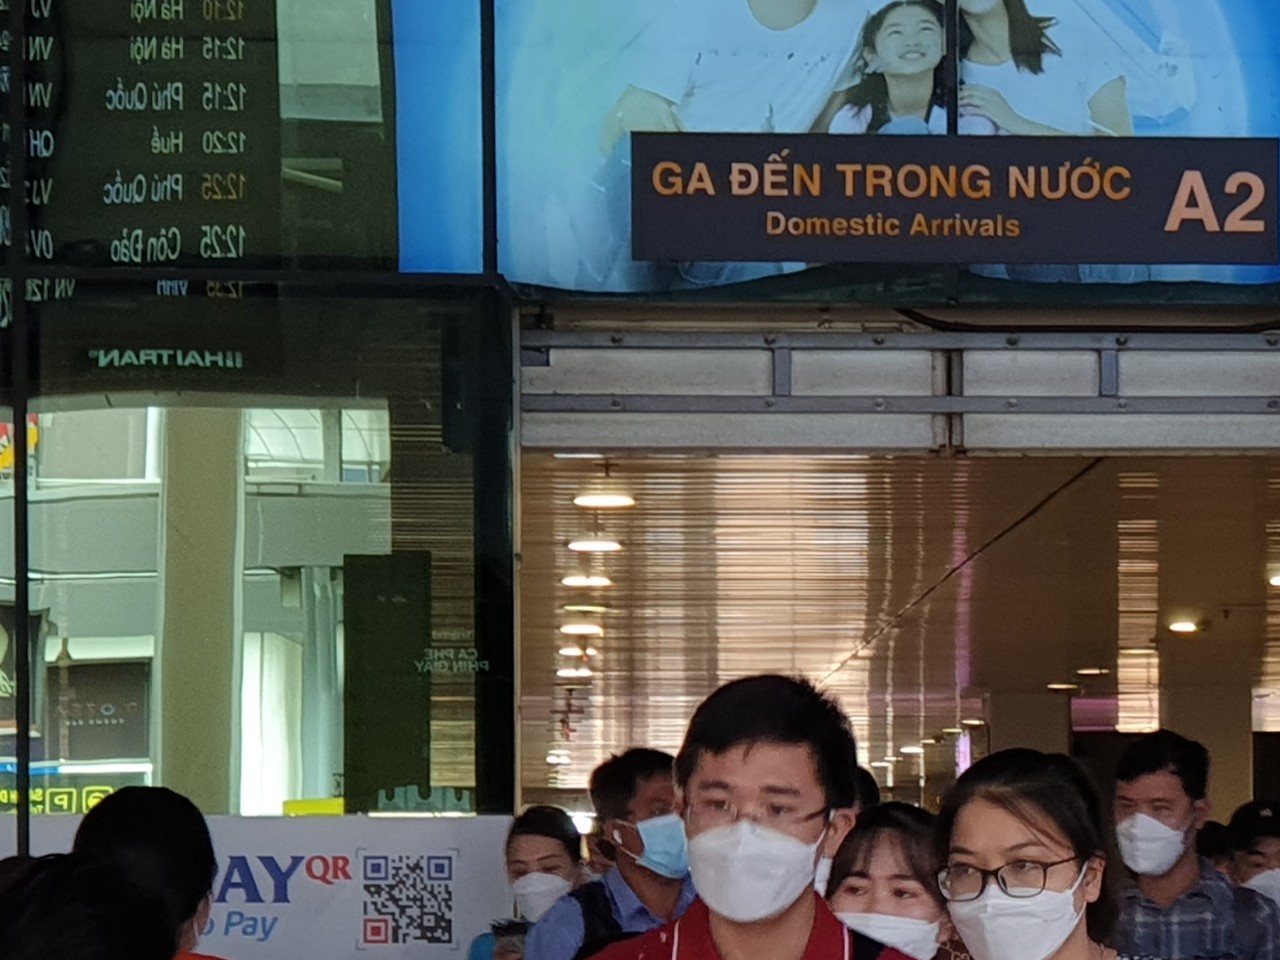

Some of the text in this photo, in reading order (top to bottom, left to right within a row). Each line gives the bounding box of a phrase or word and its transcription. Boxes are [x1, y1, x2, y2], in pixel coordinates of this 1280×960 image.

[652, 149, 1132, 201] GA ĐẾN TRONG NƯỚC
[766, 210, 1020, 239] Domestic Arrivals
[1164, 170, 1266, 233] A2
[213, 855, 352, 904] AY QR
[223, 910, 278, 942] Pay
